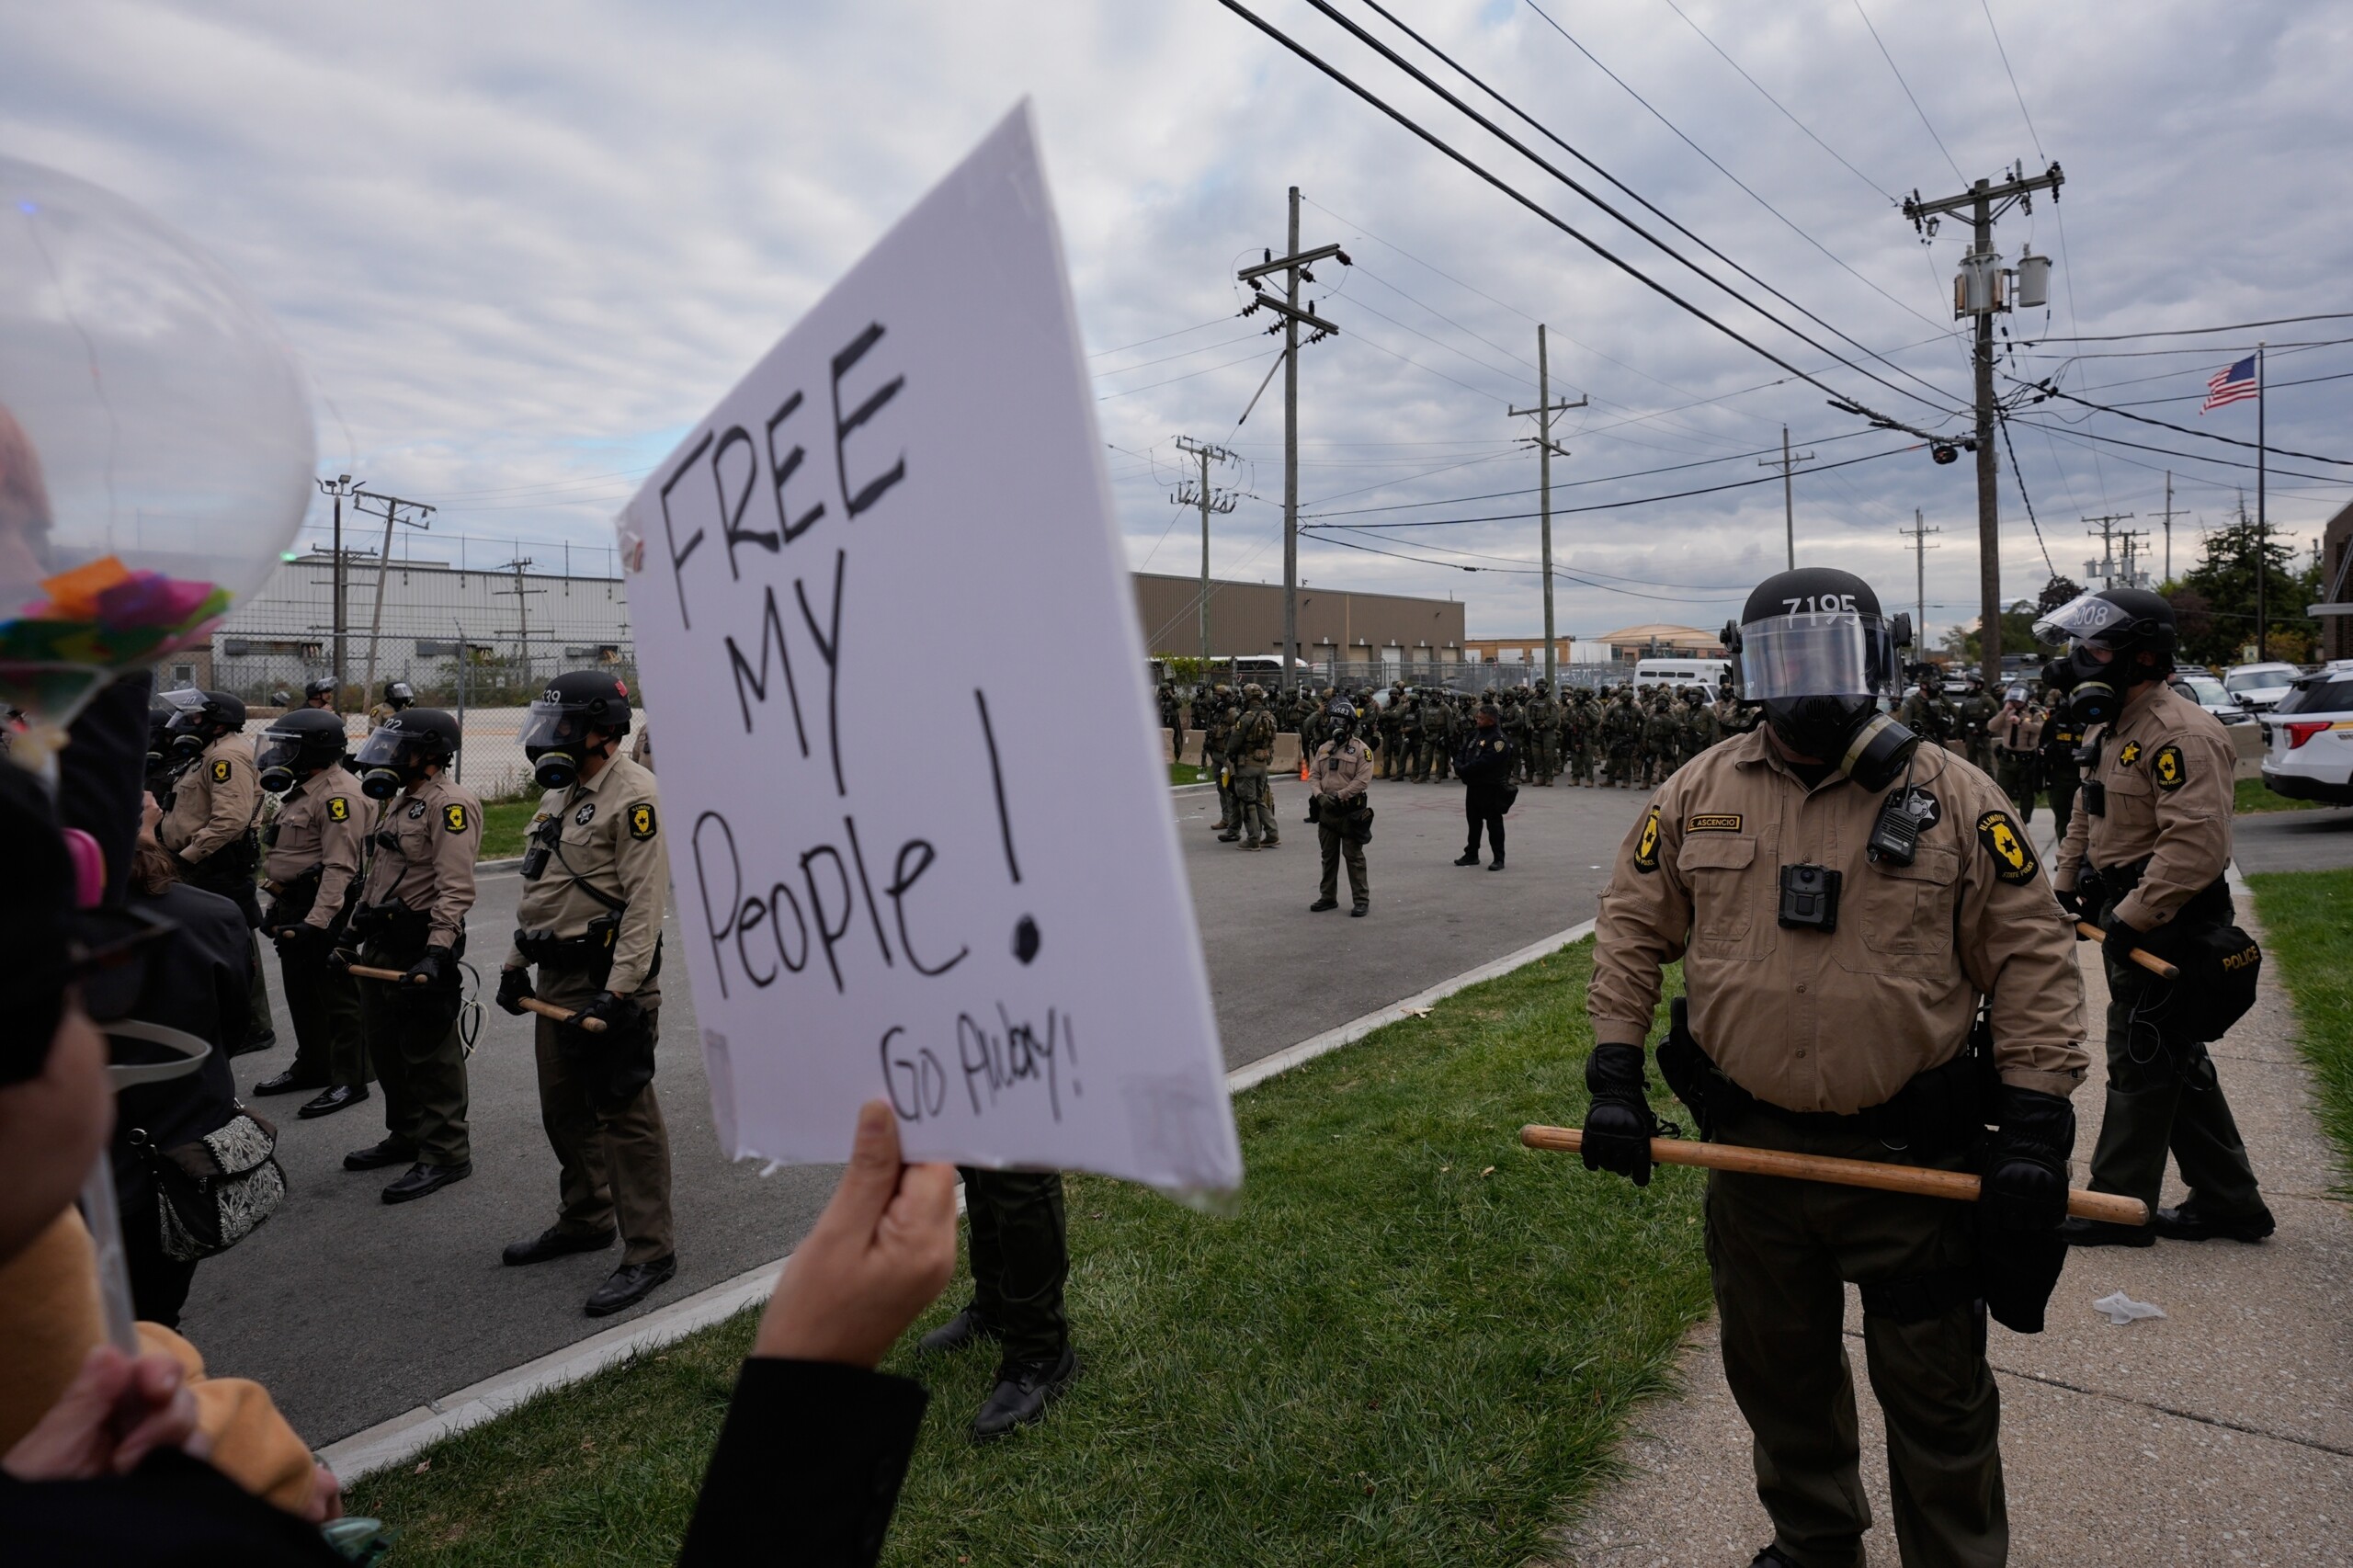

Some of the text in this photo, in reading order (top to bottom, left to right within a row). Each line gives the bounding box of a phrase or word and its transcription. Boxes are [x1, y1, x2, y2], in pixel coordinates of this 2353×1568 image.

[660, 322, 906, 631] FREE
[1782, 594, 1859, 629] 7195
[723, 549, 847, 797] MY
[1697, 818, 1735, 826] ASCENCIO
[1979, 814, 2006, 831] ILLINOIS
[2222, 946, 2259, 972] POLICE
